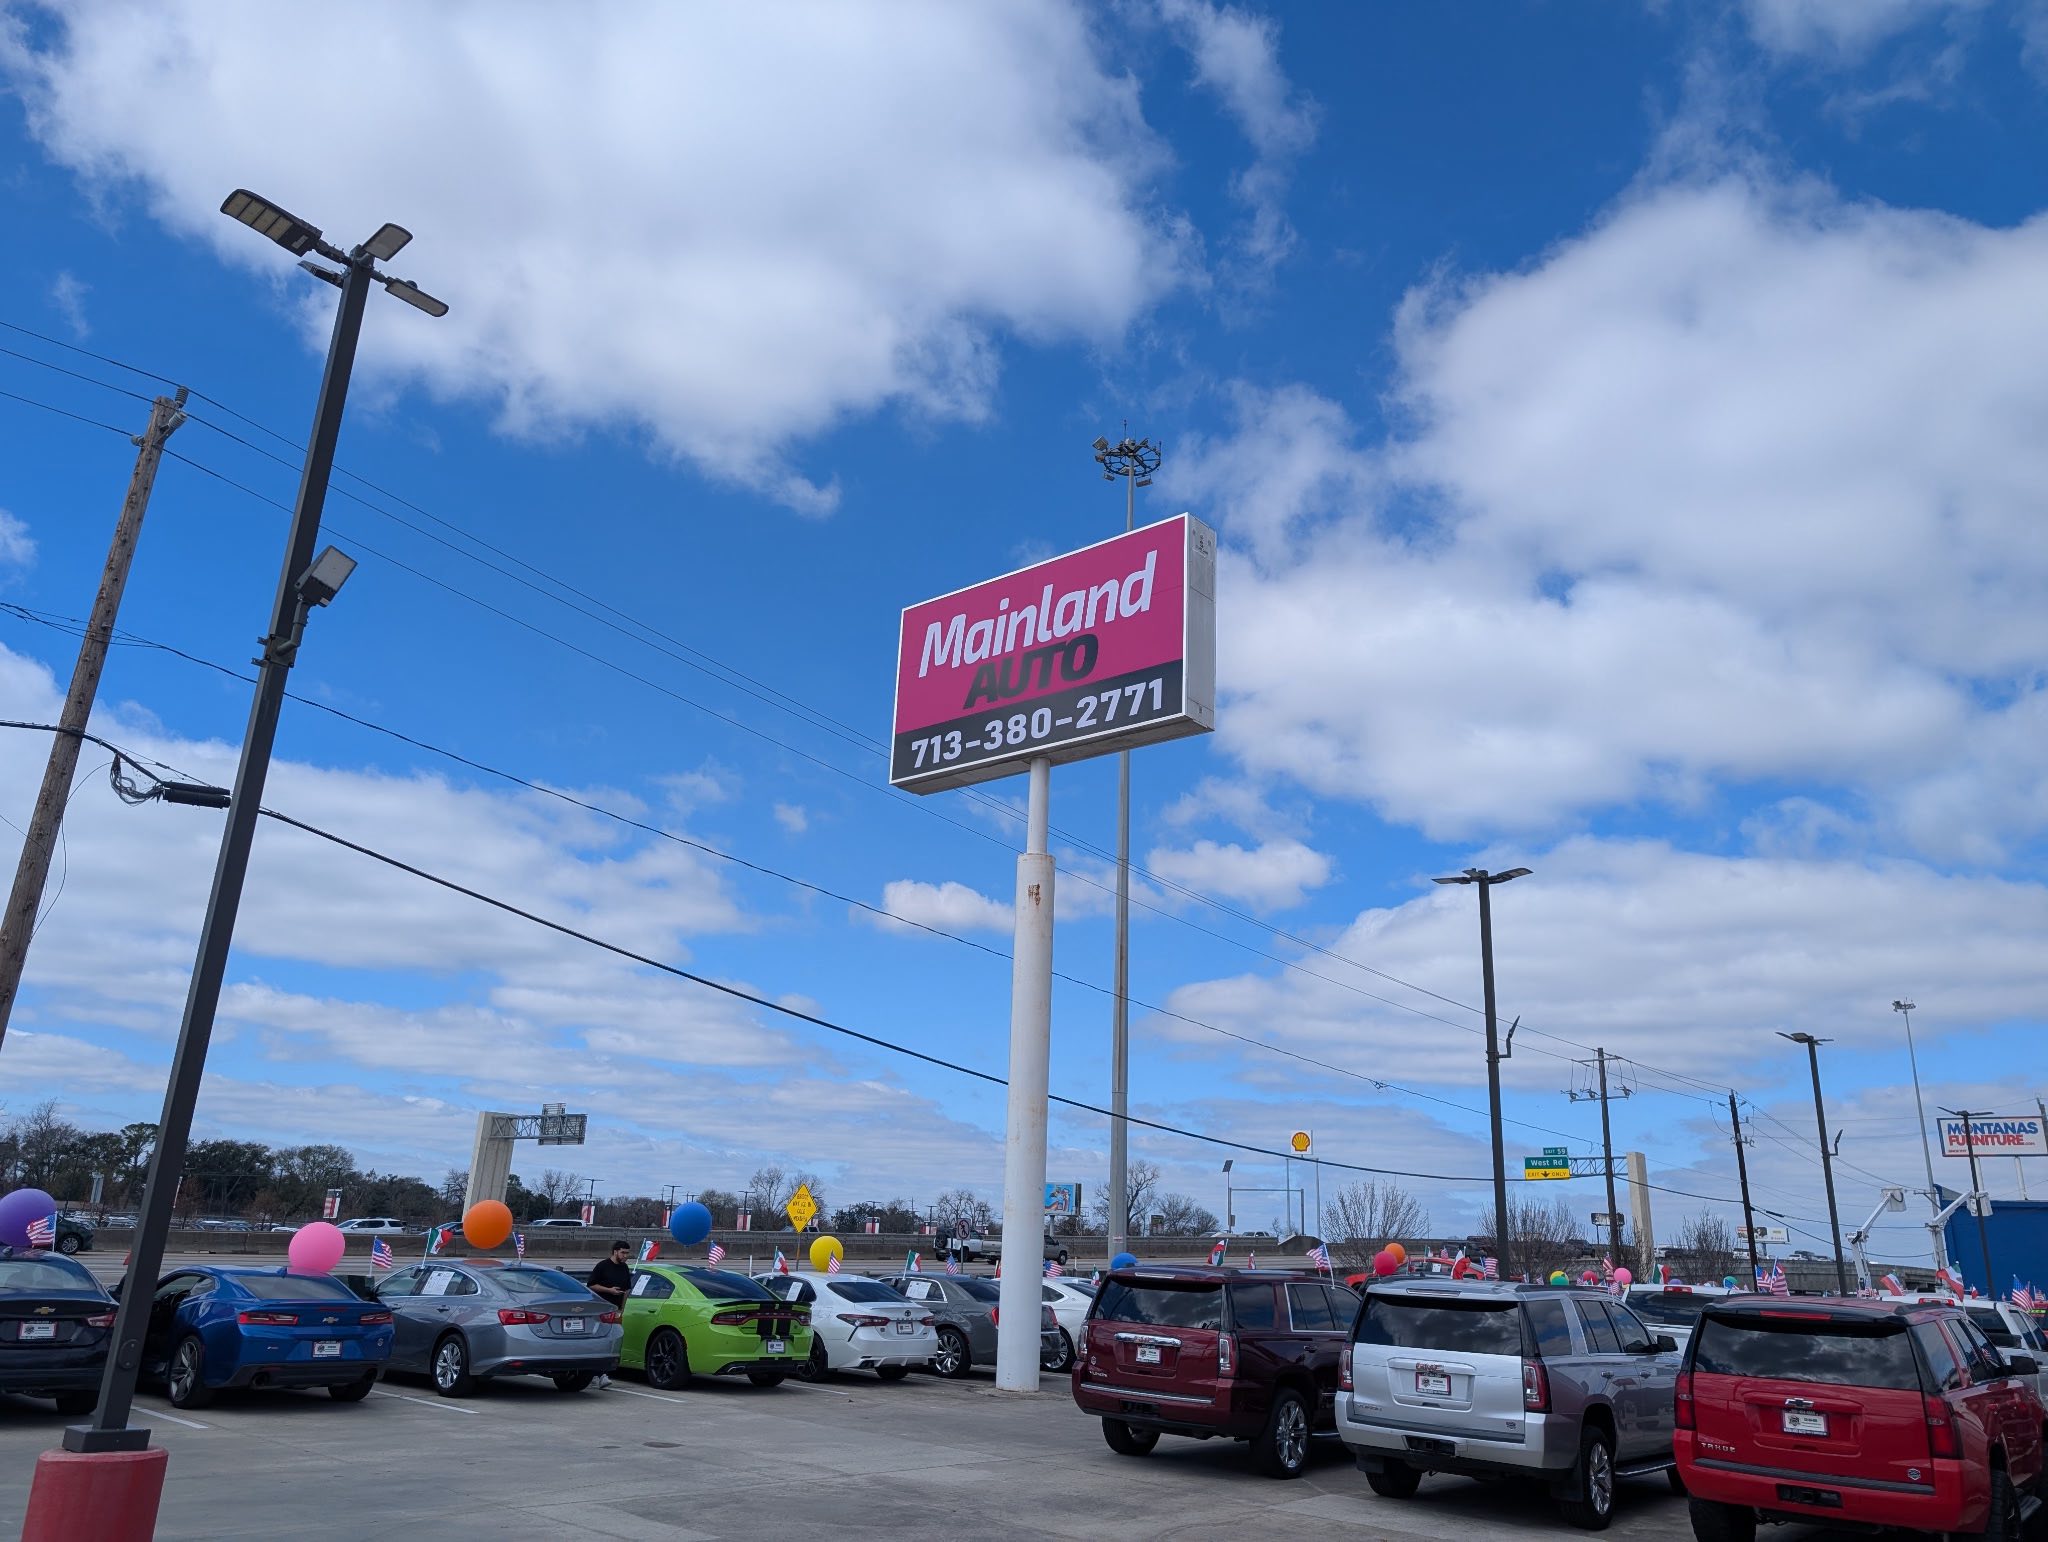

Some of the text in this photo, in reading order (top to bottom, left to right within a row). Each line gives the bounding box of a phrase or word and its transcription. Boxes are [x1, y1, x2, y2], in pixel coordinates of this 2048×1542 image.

[919, 550, 1157, 678] Mainland
[963, 633, 1099, 710] AUTO
[911, 677, 1163, 769] 713-380-2771
[1948, 1121, 2039, 1135] MONTANAS
[1701, 1442, 1736, 1453] TAHOE
